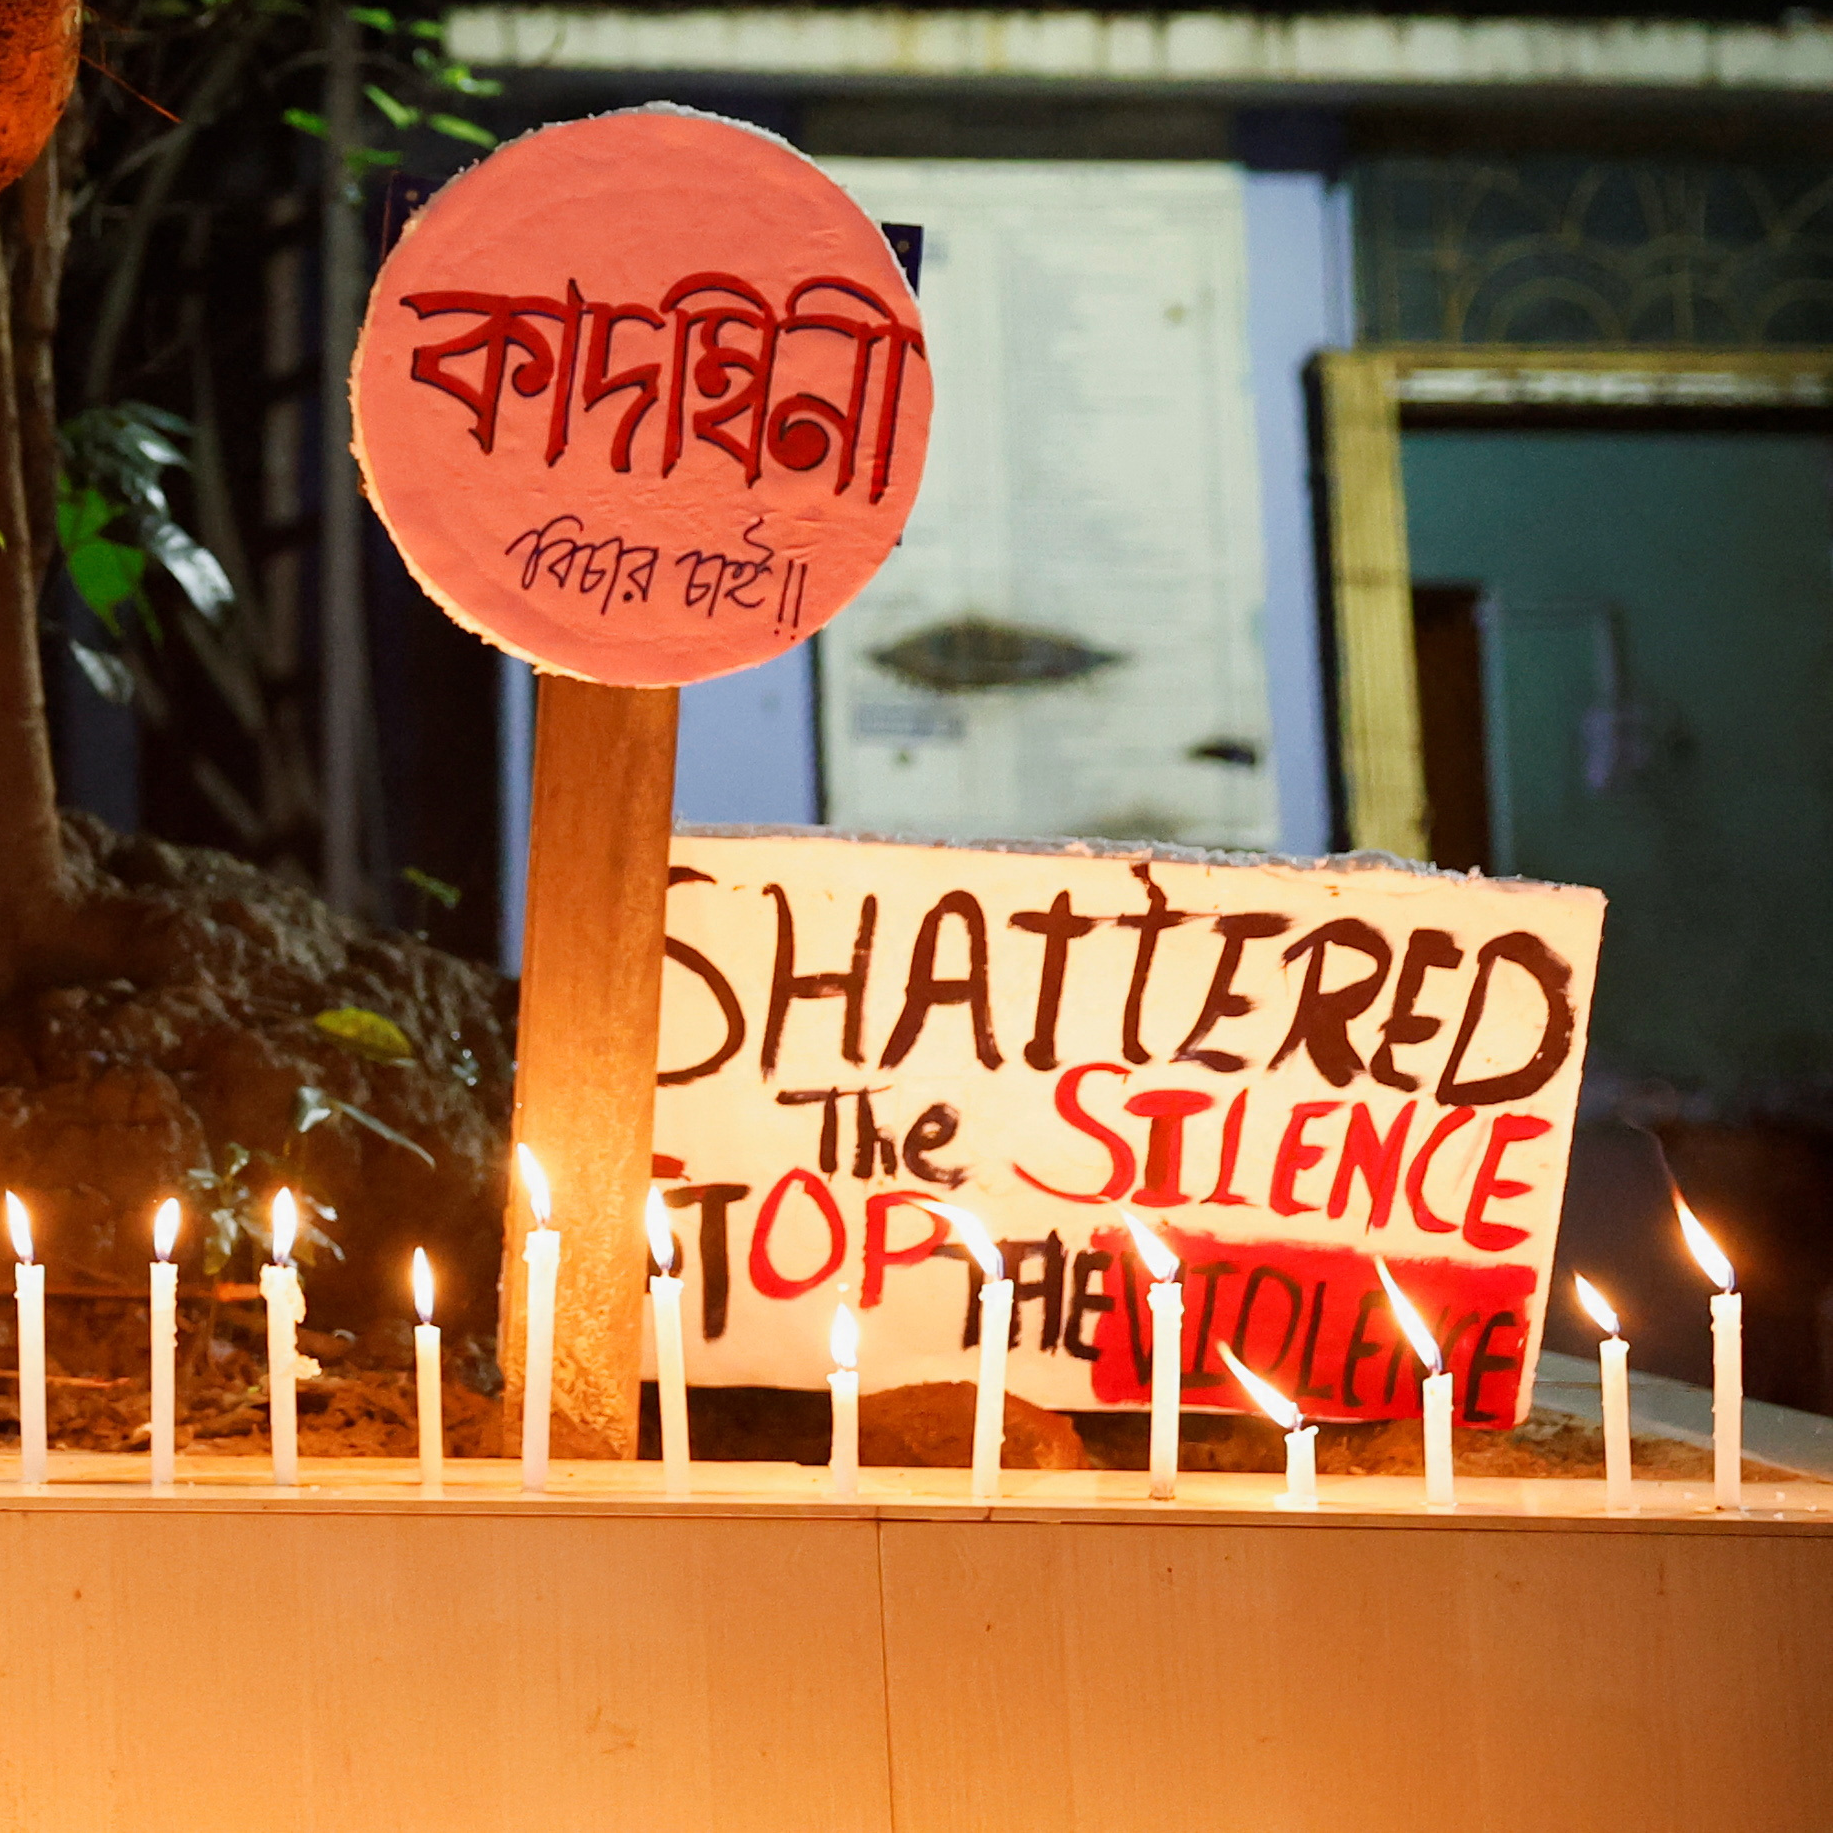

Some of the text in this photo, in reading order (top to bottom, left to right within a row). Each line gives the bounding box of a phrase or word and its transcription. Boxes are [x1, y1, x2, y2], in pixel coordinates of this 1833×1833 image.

[505, 514, 660, 616] বিচার
[776, 1062, 1553, 1251] The SILENCE
[930, 1228, 1115, 1362] THE
